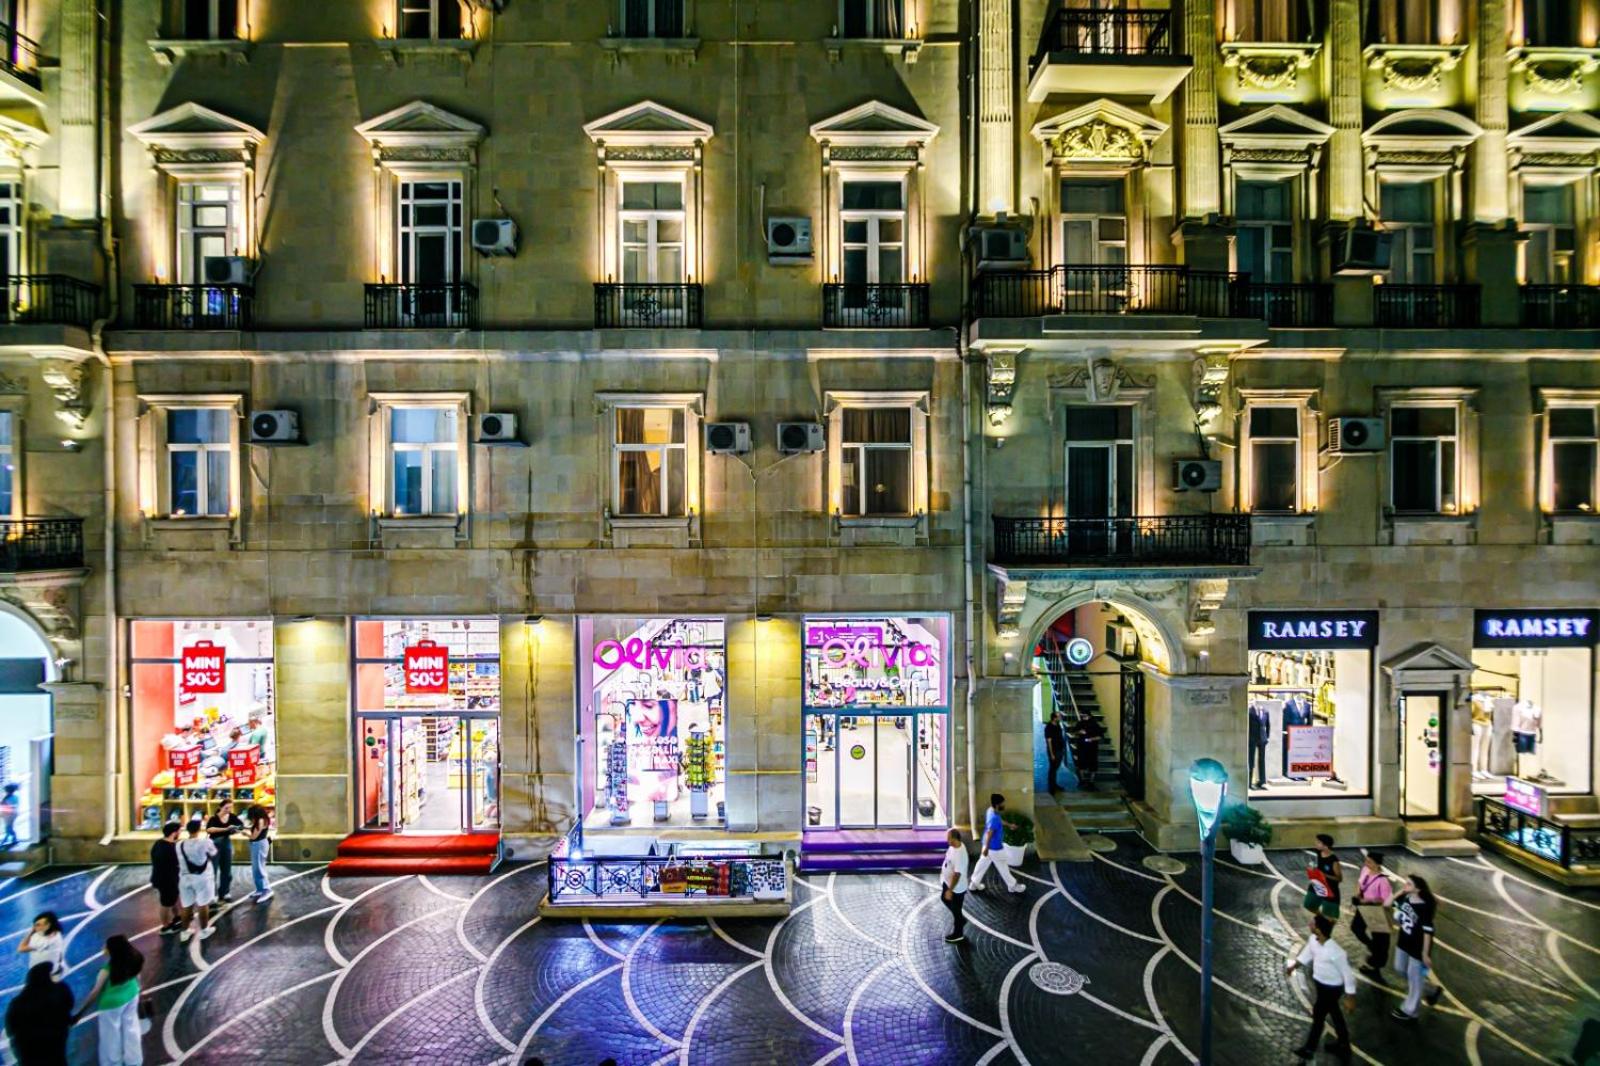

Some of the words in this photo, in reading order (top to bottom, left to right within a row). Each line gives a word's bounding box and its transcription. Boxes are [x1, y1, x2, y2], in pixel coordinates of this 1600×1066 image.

[1262, 620, 1367, 638] RAMSEY
[1486, 618, 1591, 637] RAMSEY
[593, 637, 707, 669] Olivia
[822, 636, 935, 668] Olivia
[185, 656, 220, 670] MINI
[408, 656, 443, 670] MINI
